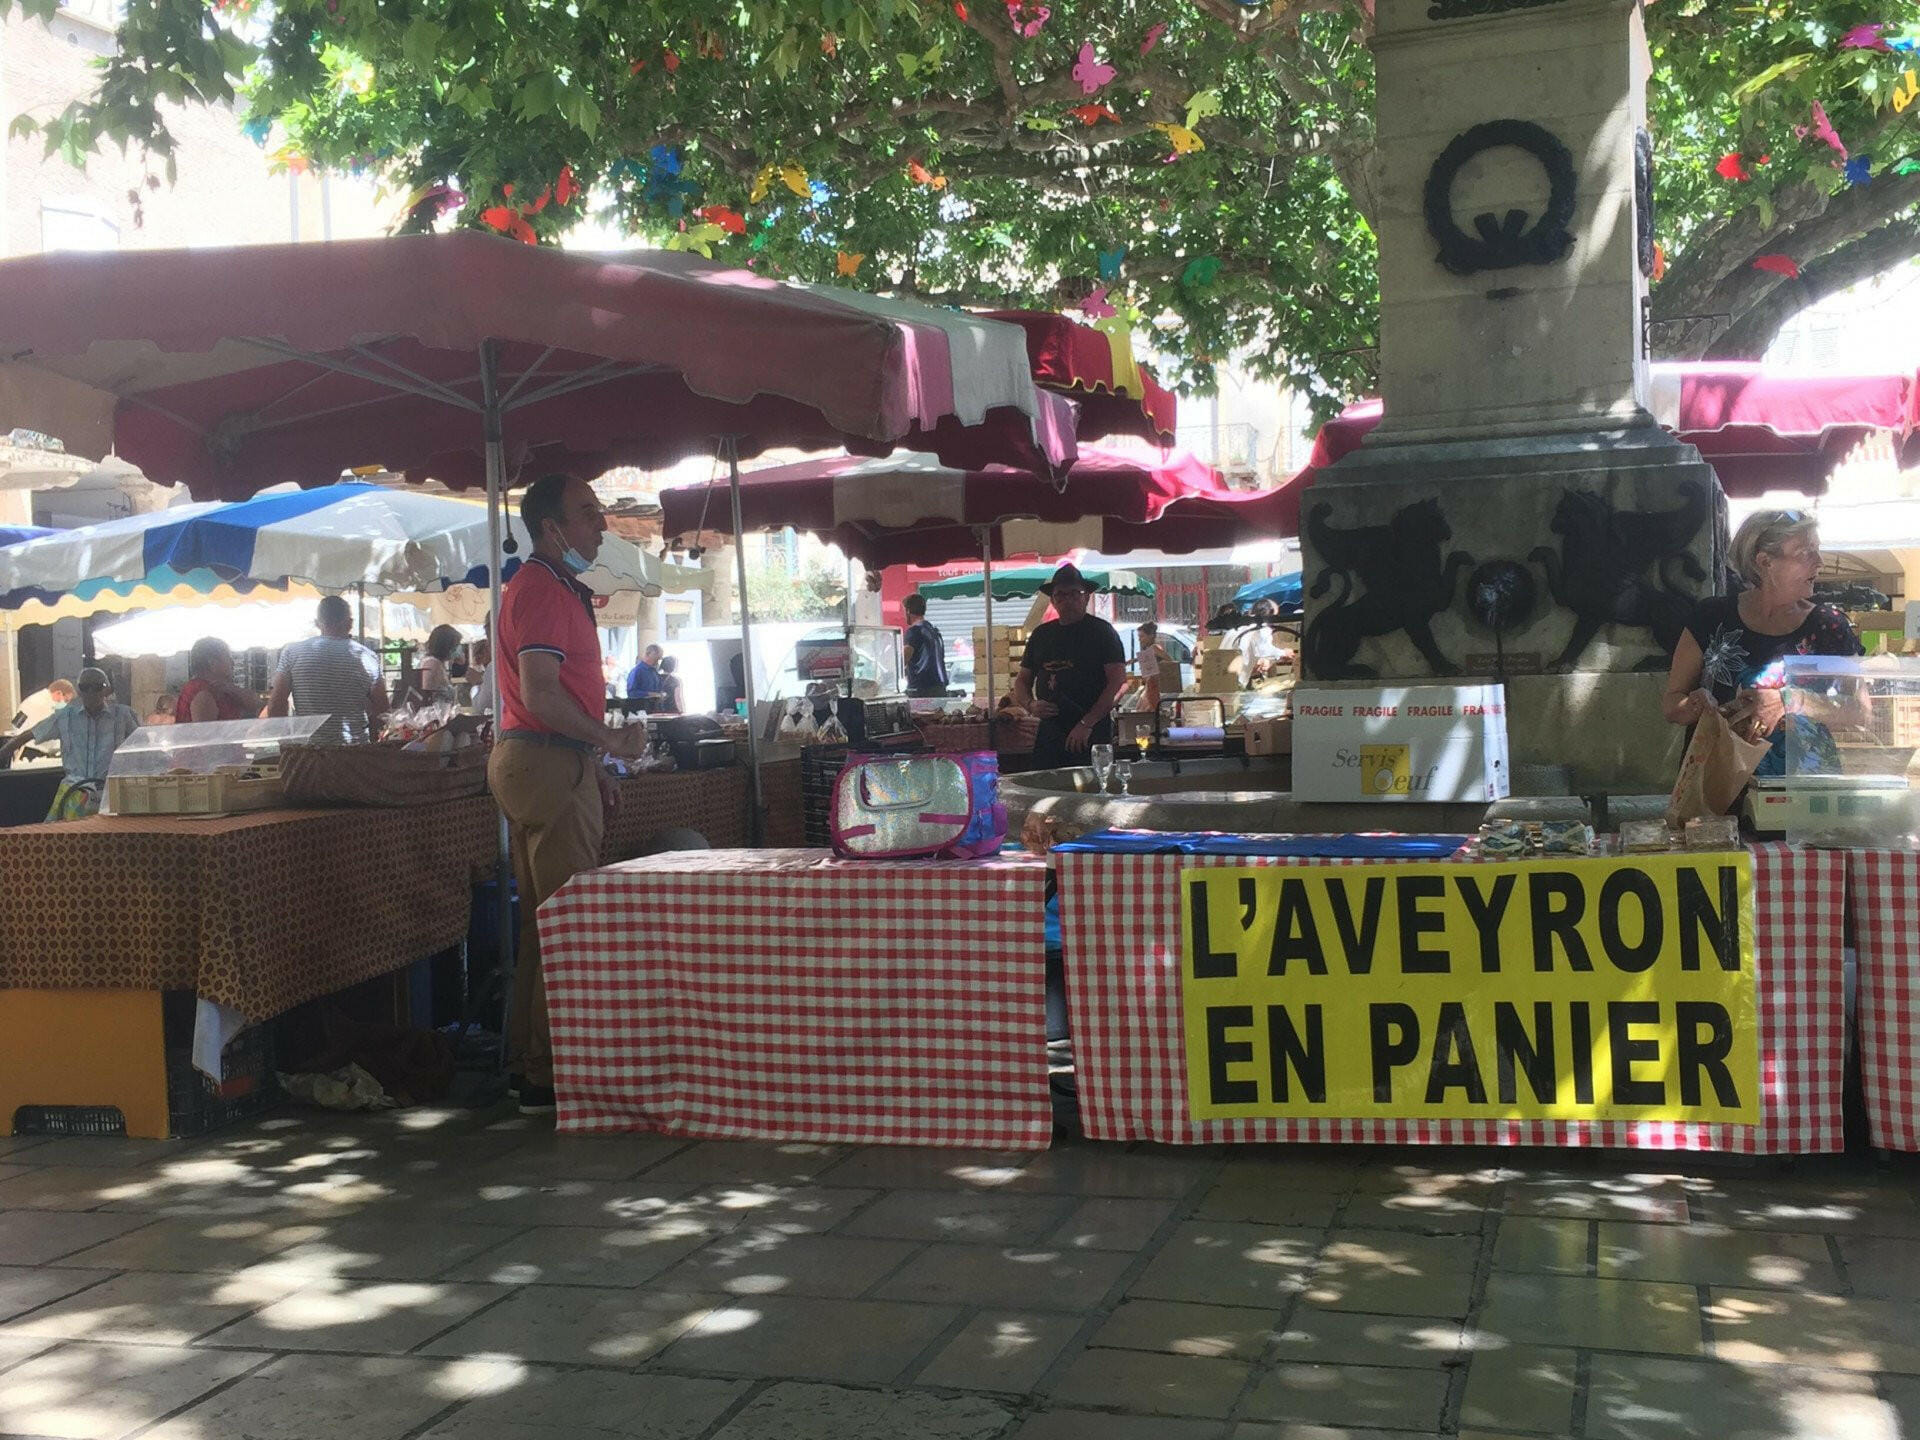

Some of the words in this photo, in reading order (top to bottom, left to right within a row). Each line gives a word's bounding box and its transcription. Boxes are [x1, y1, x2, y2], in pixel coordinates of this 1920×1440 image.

[1299, 706, 1344, 717] FRAGILE
[1352, 706, 1398, 717] FRAGILE
[1407, 705, 1453, 716] FRAGILE
[1189, 866, 1741, 979] L'AVEYRON
[1206, 1003, 1327, 1105] EN
[1368, 1001, 1742, 1109] PANIER
